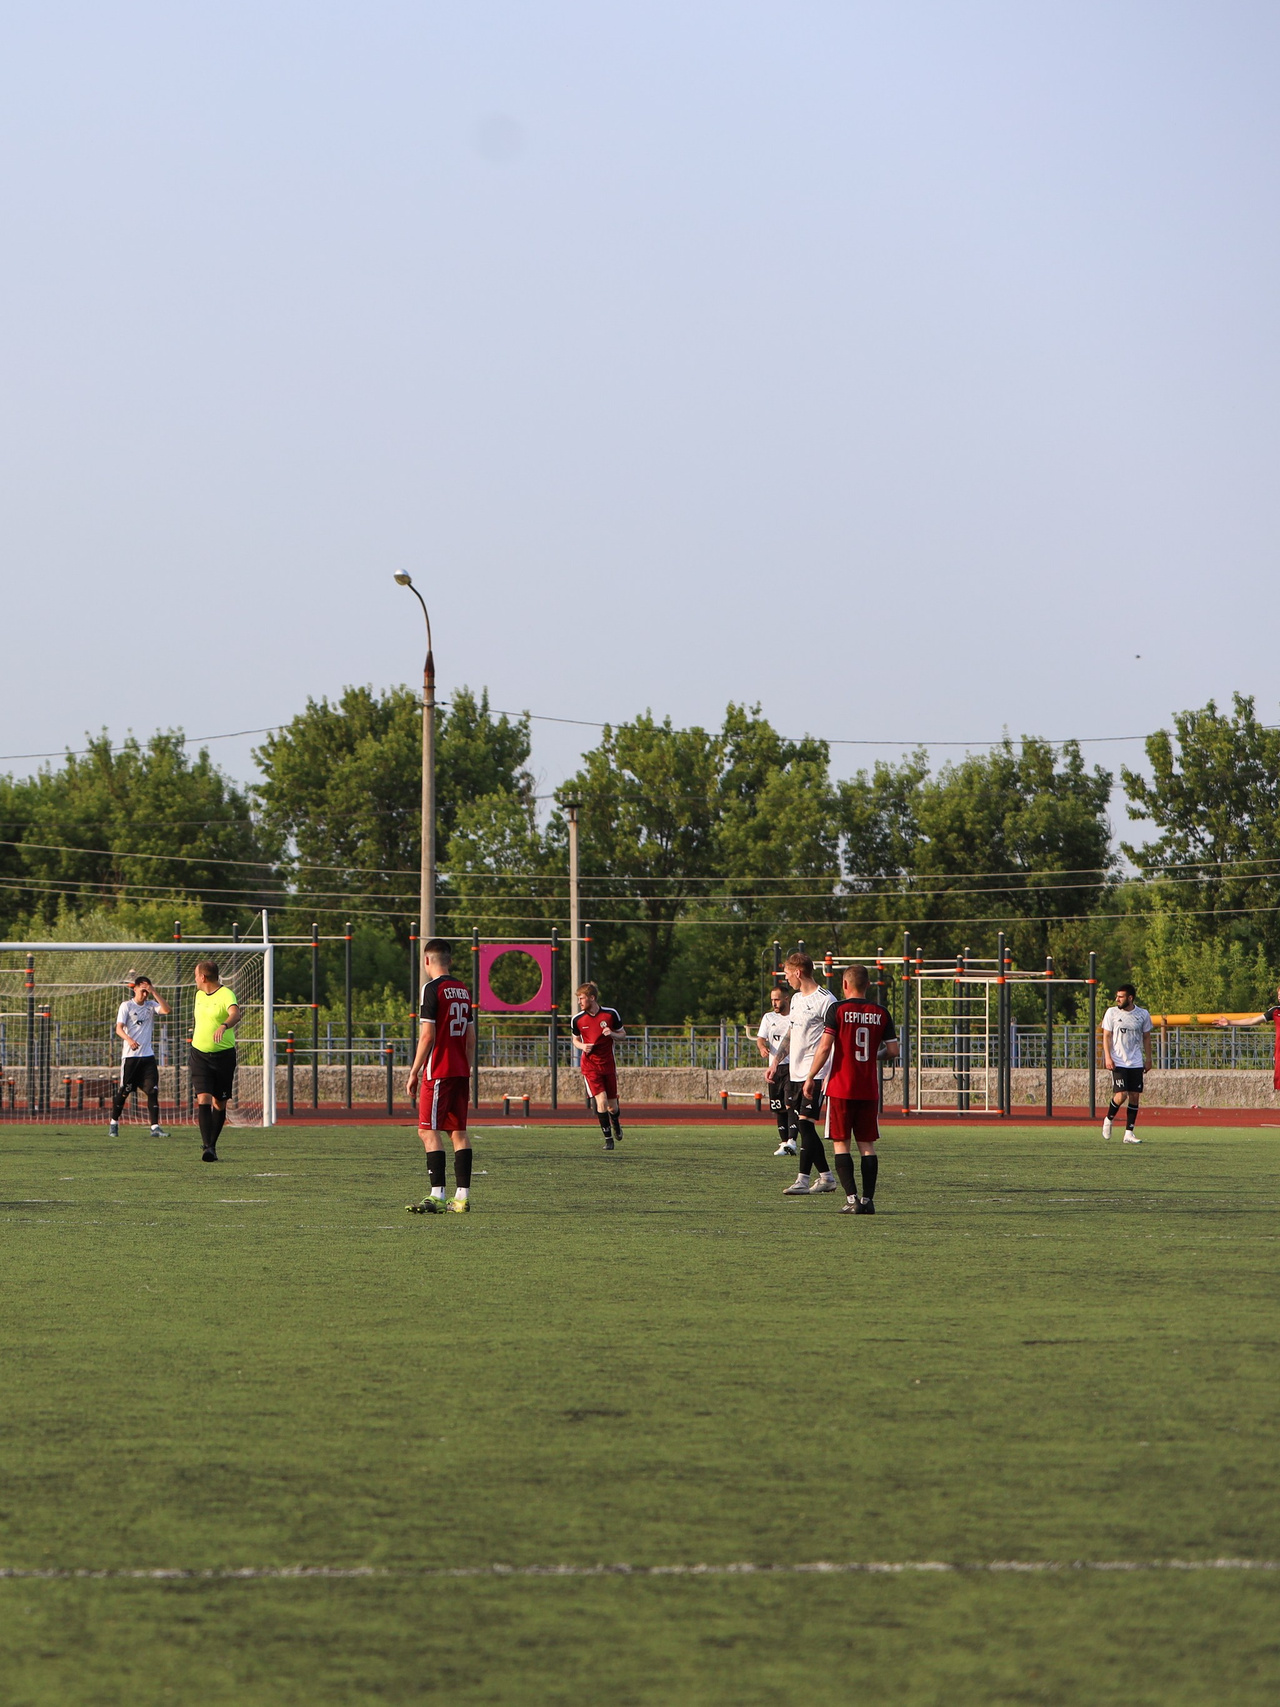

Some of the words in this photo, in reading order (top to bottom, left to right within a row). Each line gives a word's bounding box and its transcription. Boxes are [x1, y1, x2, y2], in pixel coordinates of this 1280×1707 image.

[450, 1001, 469, 1037] 26
[844, 1011, 882, 1025] СЕРГИЕВСК
[855, 1026, 870, 1062] 9
[770, 1099, 782, 1110] 23
